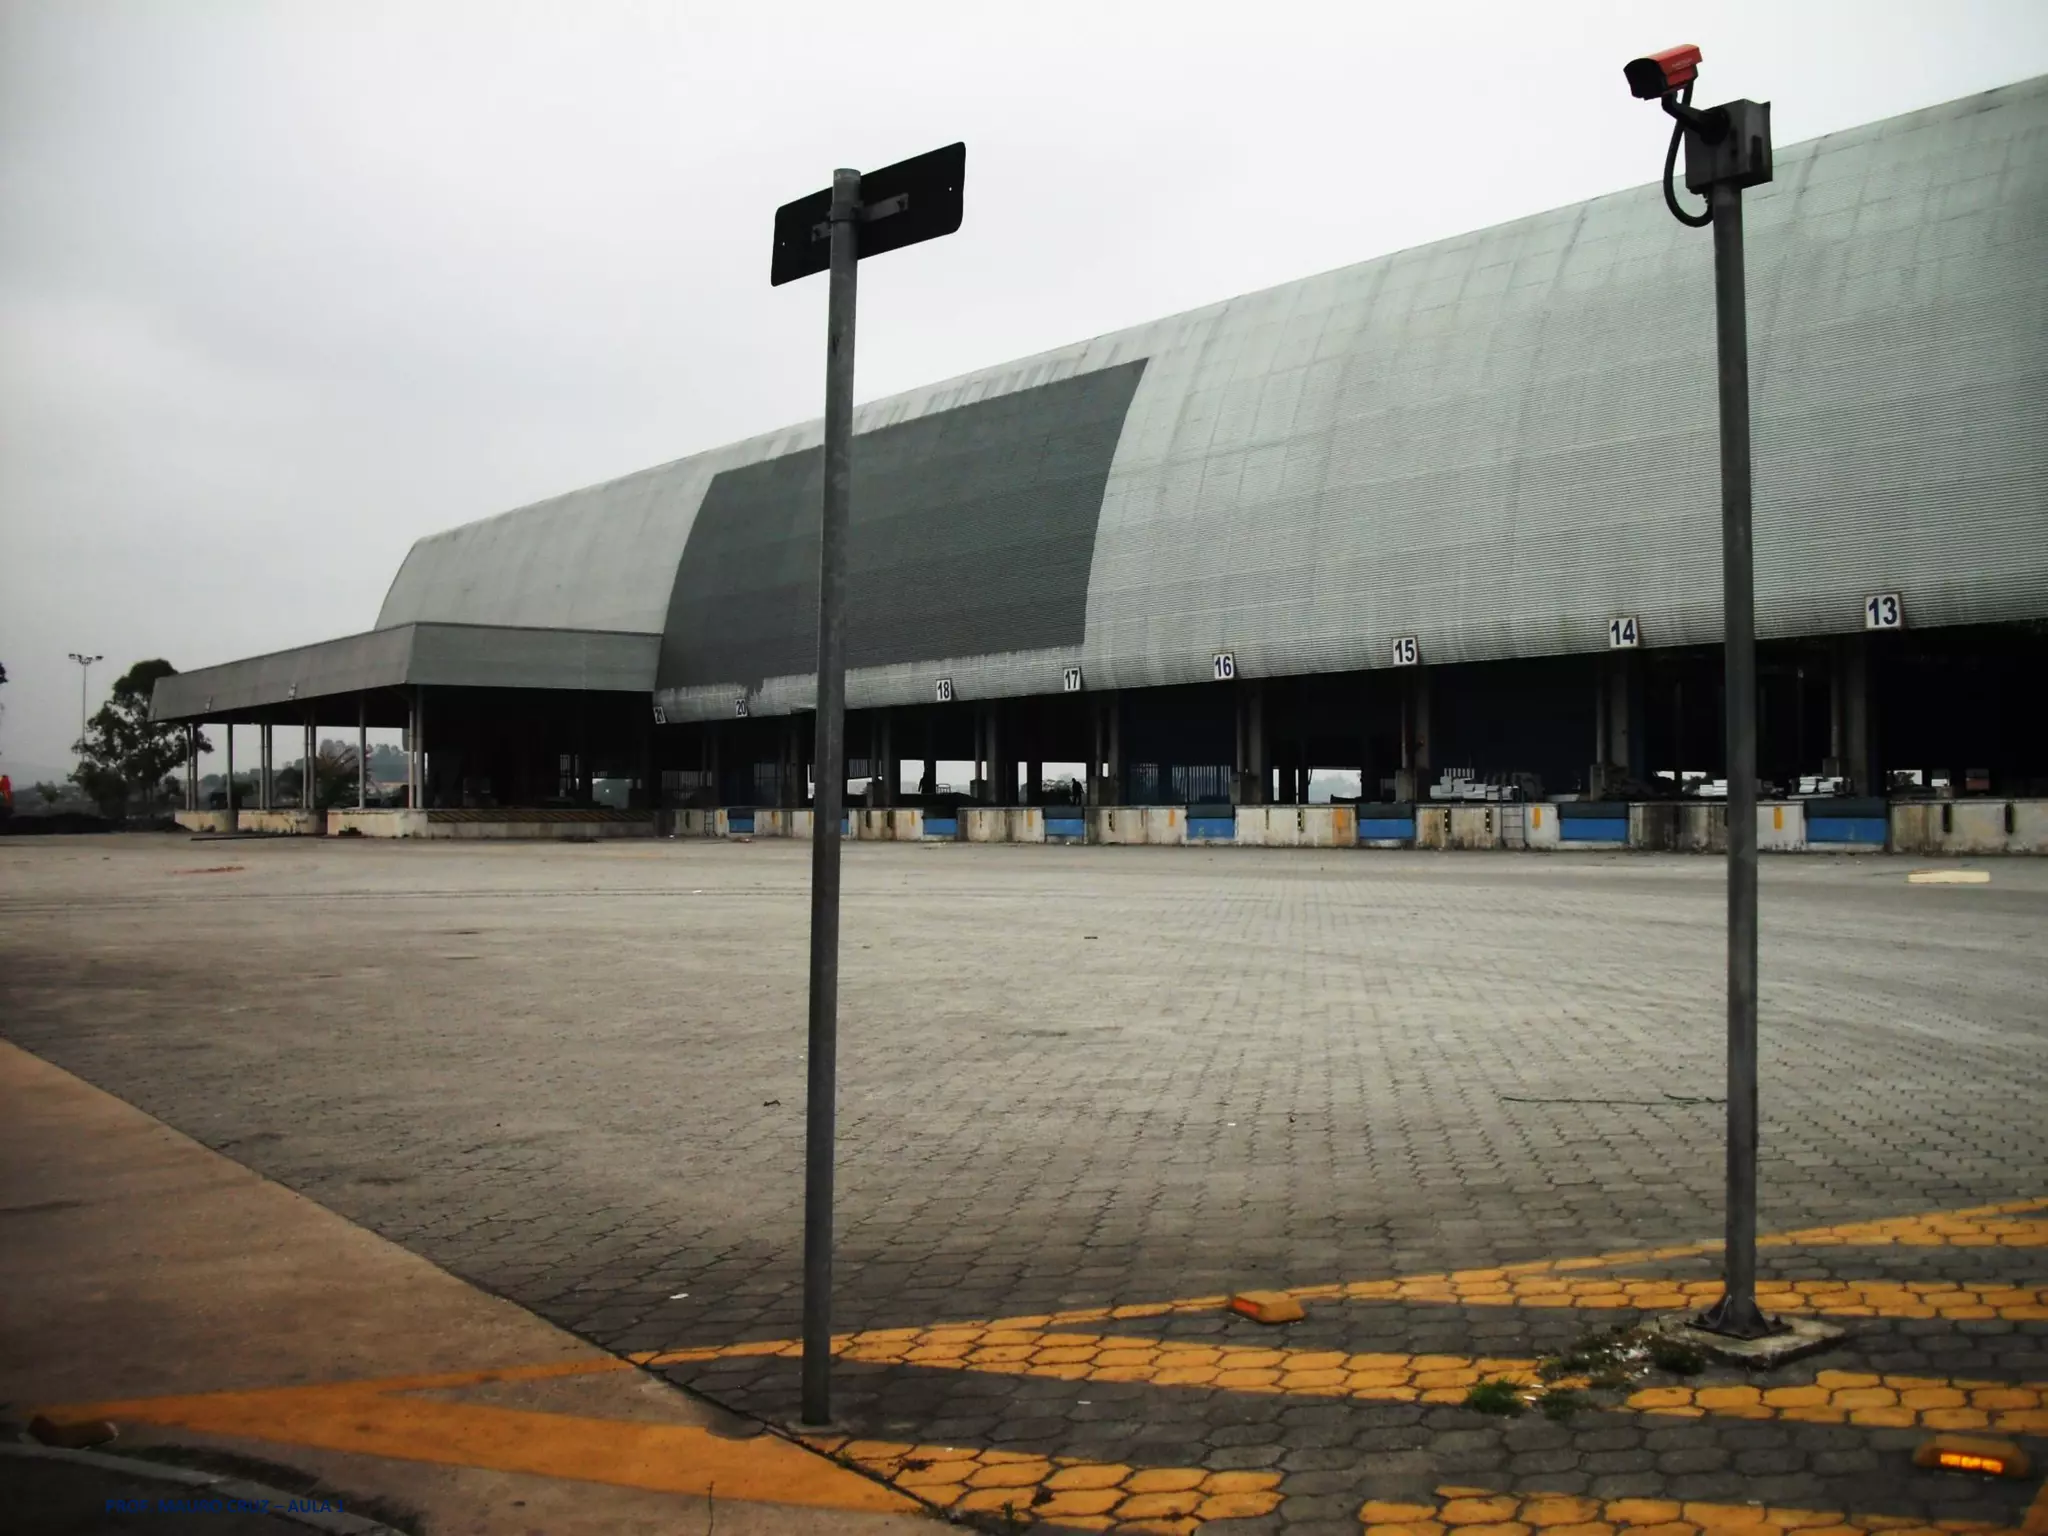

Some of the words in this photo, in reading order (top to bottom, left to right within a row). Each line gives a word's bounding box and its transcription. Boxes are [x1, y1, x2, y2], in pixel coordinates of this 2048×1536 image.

[1868, 596, 1898, 626] 13
[1611, 619, 1636, 645] 14
[1394, 639, 1415, 663] 15
[1214, 655, 1232, 677] 16
[1065, 670, 1079, 688] 17
[937, 681, 950, 700] 18
[736, 700, 746, 716] 20
